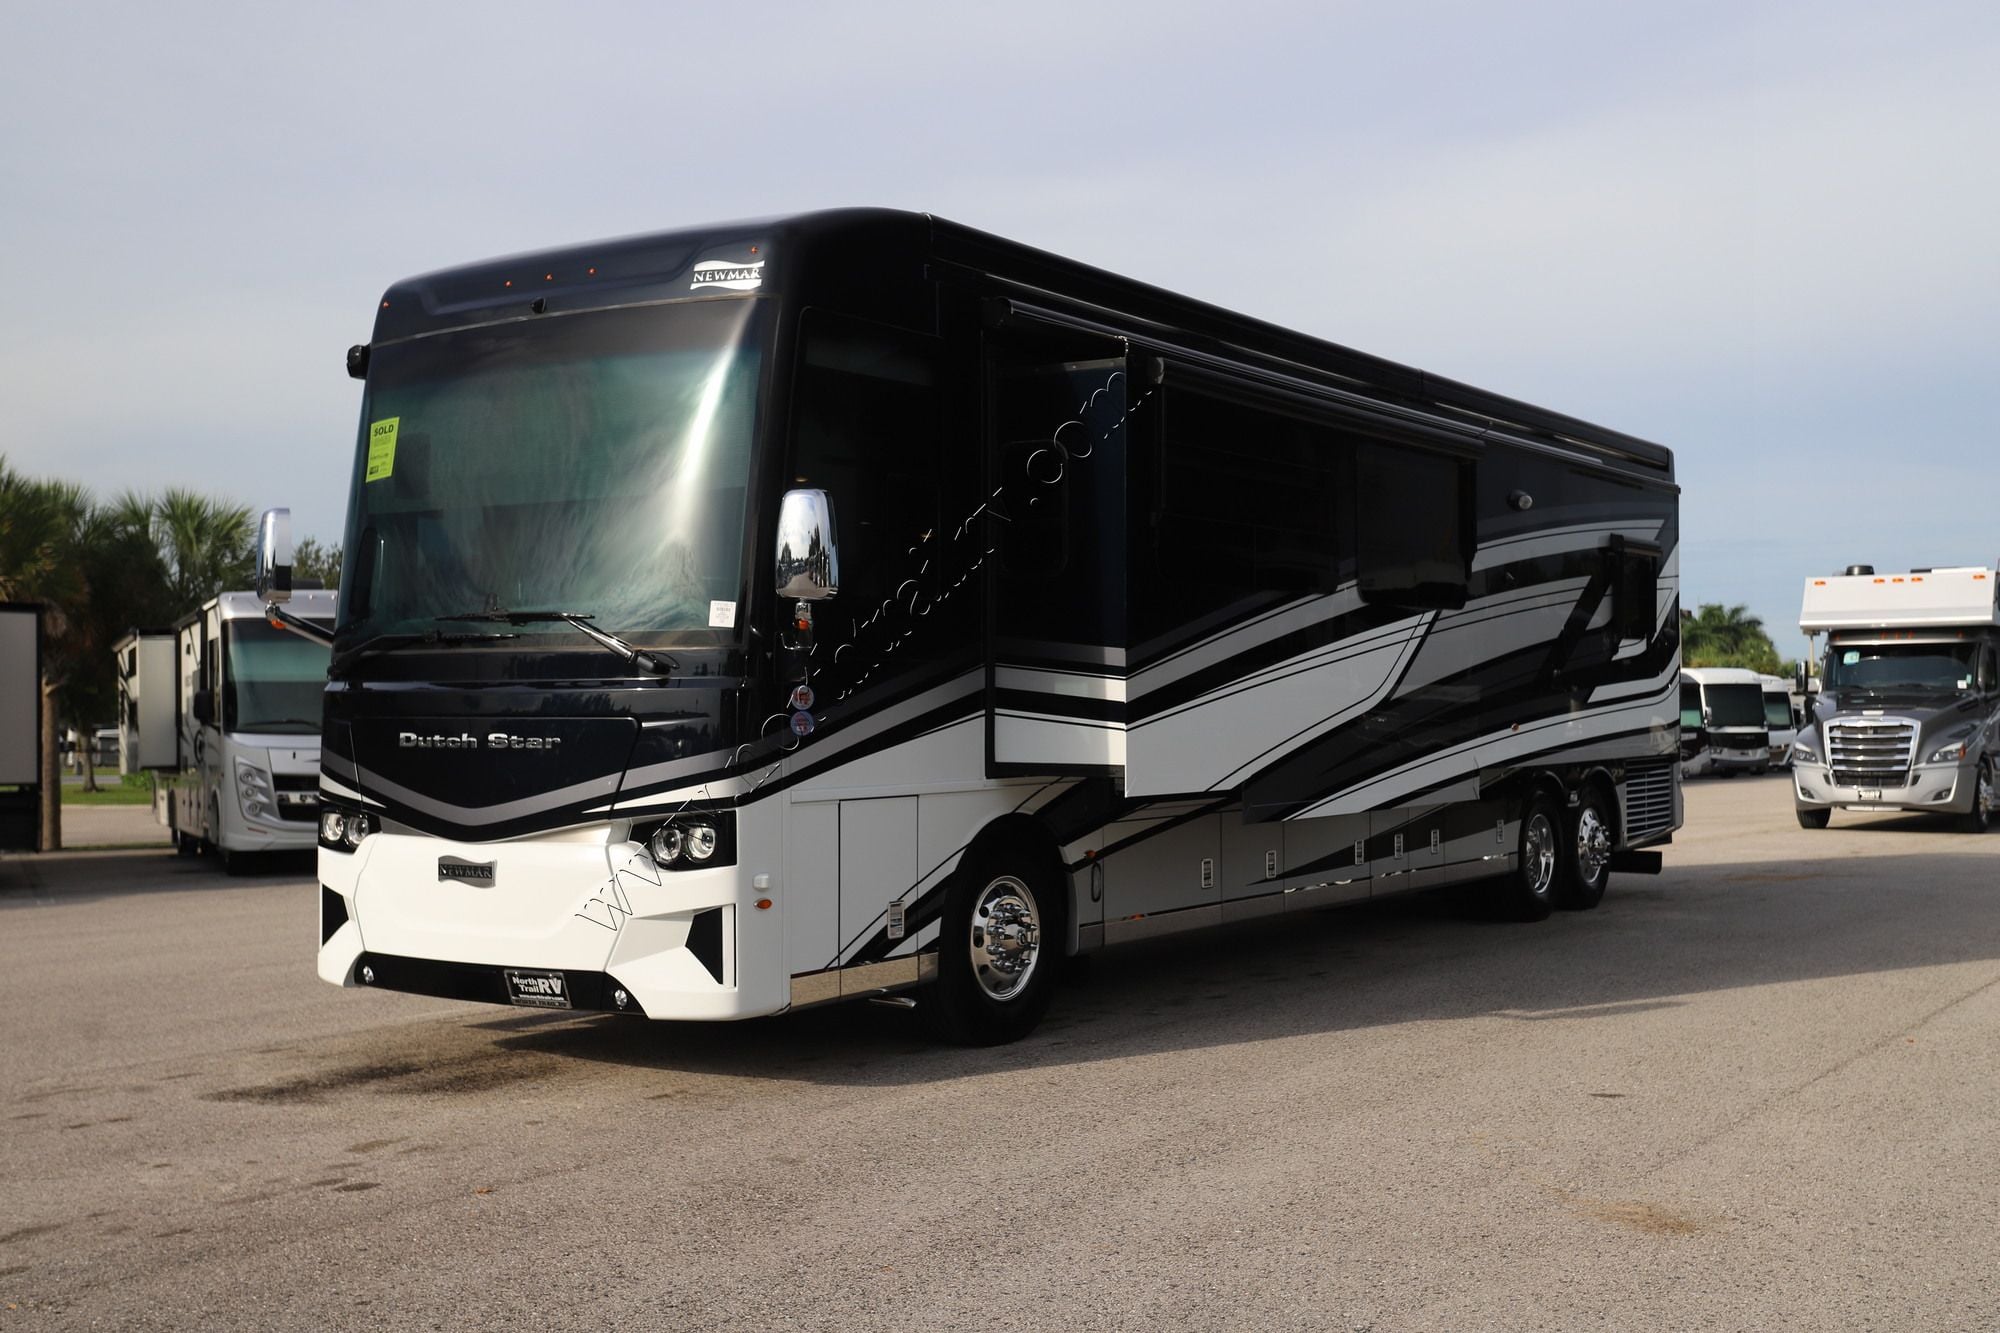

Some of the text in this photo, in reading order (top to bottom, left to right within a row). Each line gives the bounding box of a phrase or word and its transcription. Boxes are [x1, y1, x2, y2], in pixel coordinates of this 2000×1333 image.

[693, 268, 761, 282] NEWMAR
[374, 424, 394, 437] SOLD
[399, 732, 561, 749] Dutch Star
[511, 976, 538, 986] North
[536, 977, 562, 994] RV
[518, 984, 540, 993] Trail
